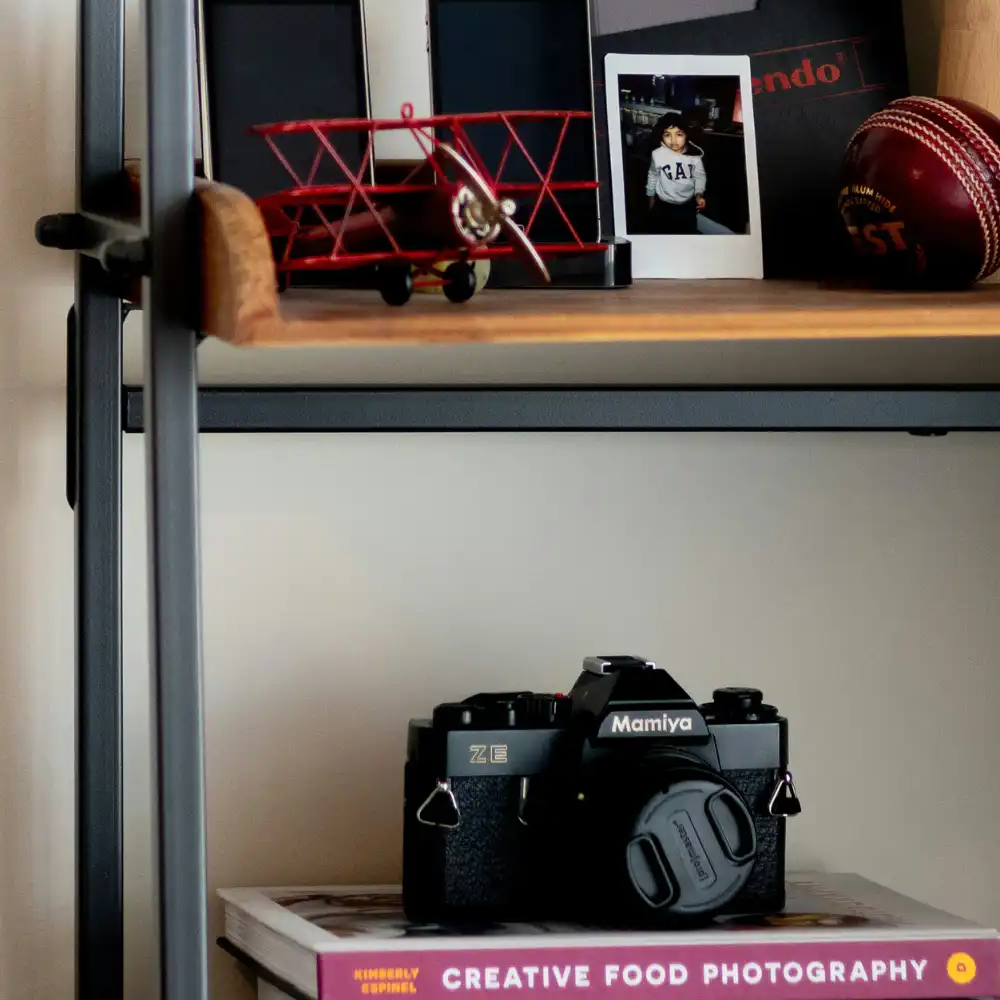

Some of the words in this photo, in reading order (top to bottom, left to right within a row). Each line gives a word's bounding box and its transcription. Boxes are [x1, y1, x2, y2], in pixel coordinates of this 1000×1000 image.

[611, 713, 693, 733] Mamiya
[469, 744, 508, 764] ZE
[354, 967, 419, 981] KIMBERLY
[442, 965, 591, 990] CREATIVE
[604, 963, 688, 987] FOOD
[703, 959, 928, 985] PHOTOGRAPHY
